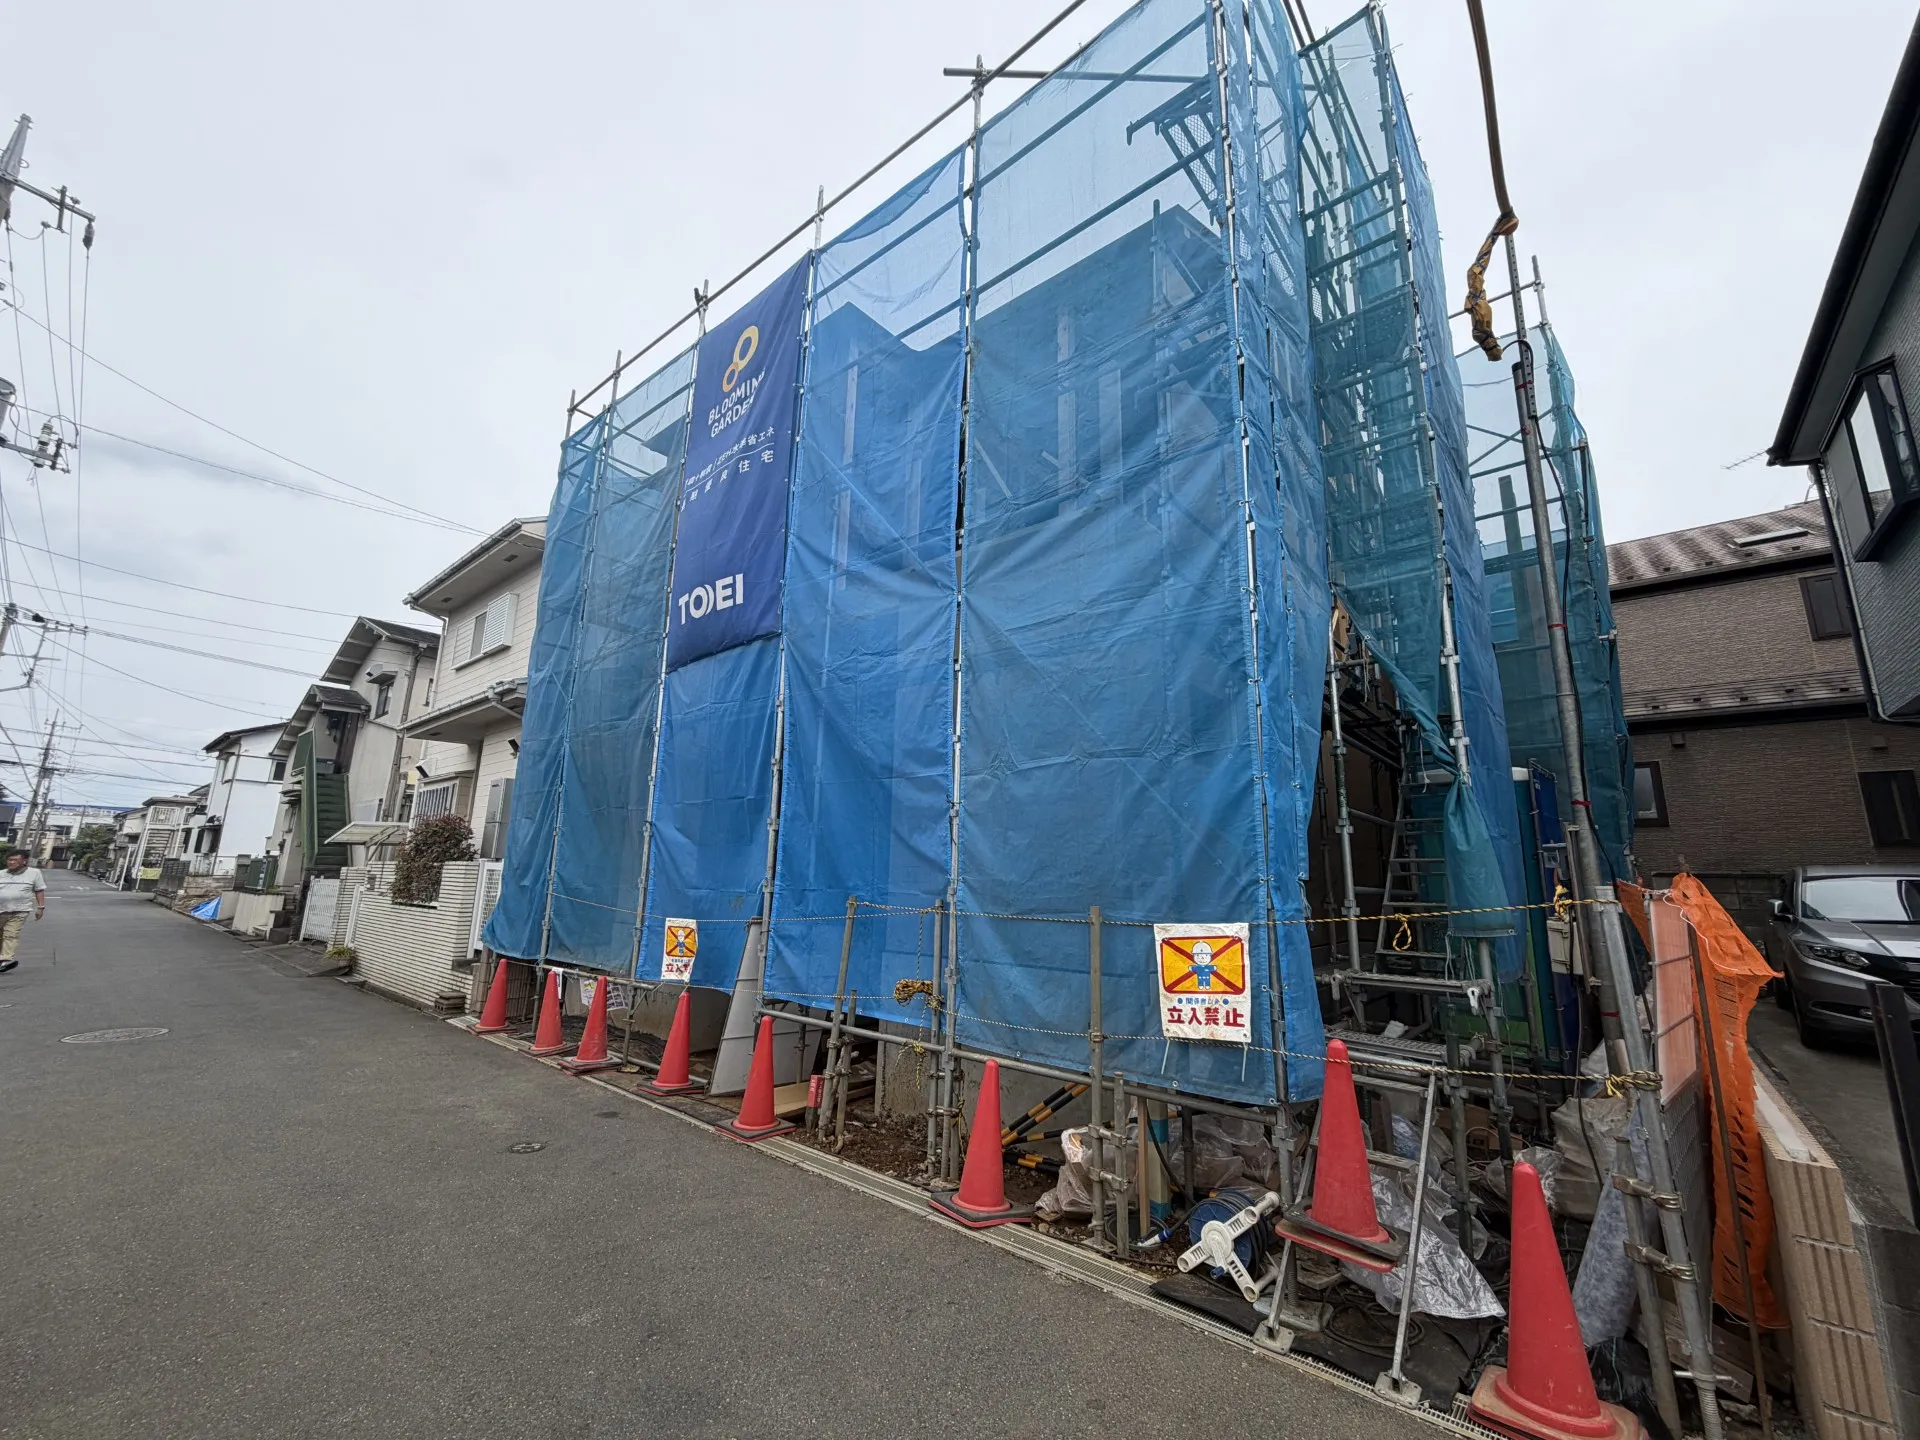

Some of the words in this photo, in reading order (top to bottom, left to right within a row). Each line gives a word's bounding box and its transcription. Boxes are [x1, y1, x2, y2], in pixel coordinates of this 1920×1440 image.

[711, 391, 756, 438] GARDEN
[678, 573, 744, 626] TOEI
[1167, 1005, 1246, 1028] 立入禁止
[1185, 997, 1221, 1006] 関係者以外
